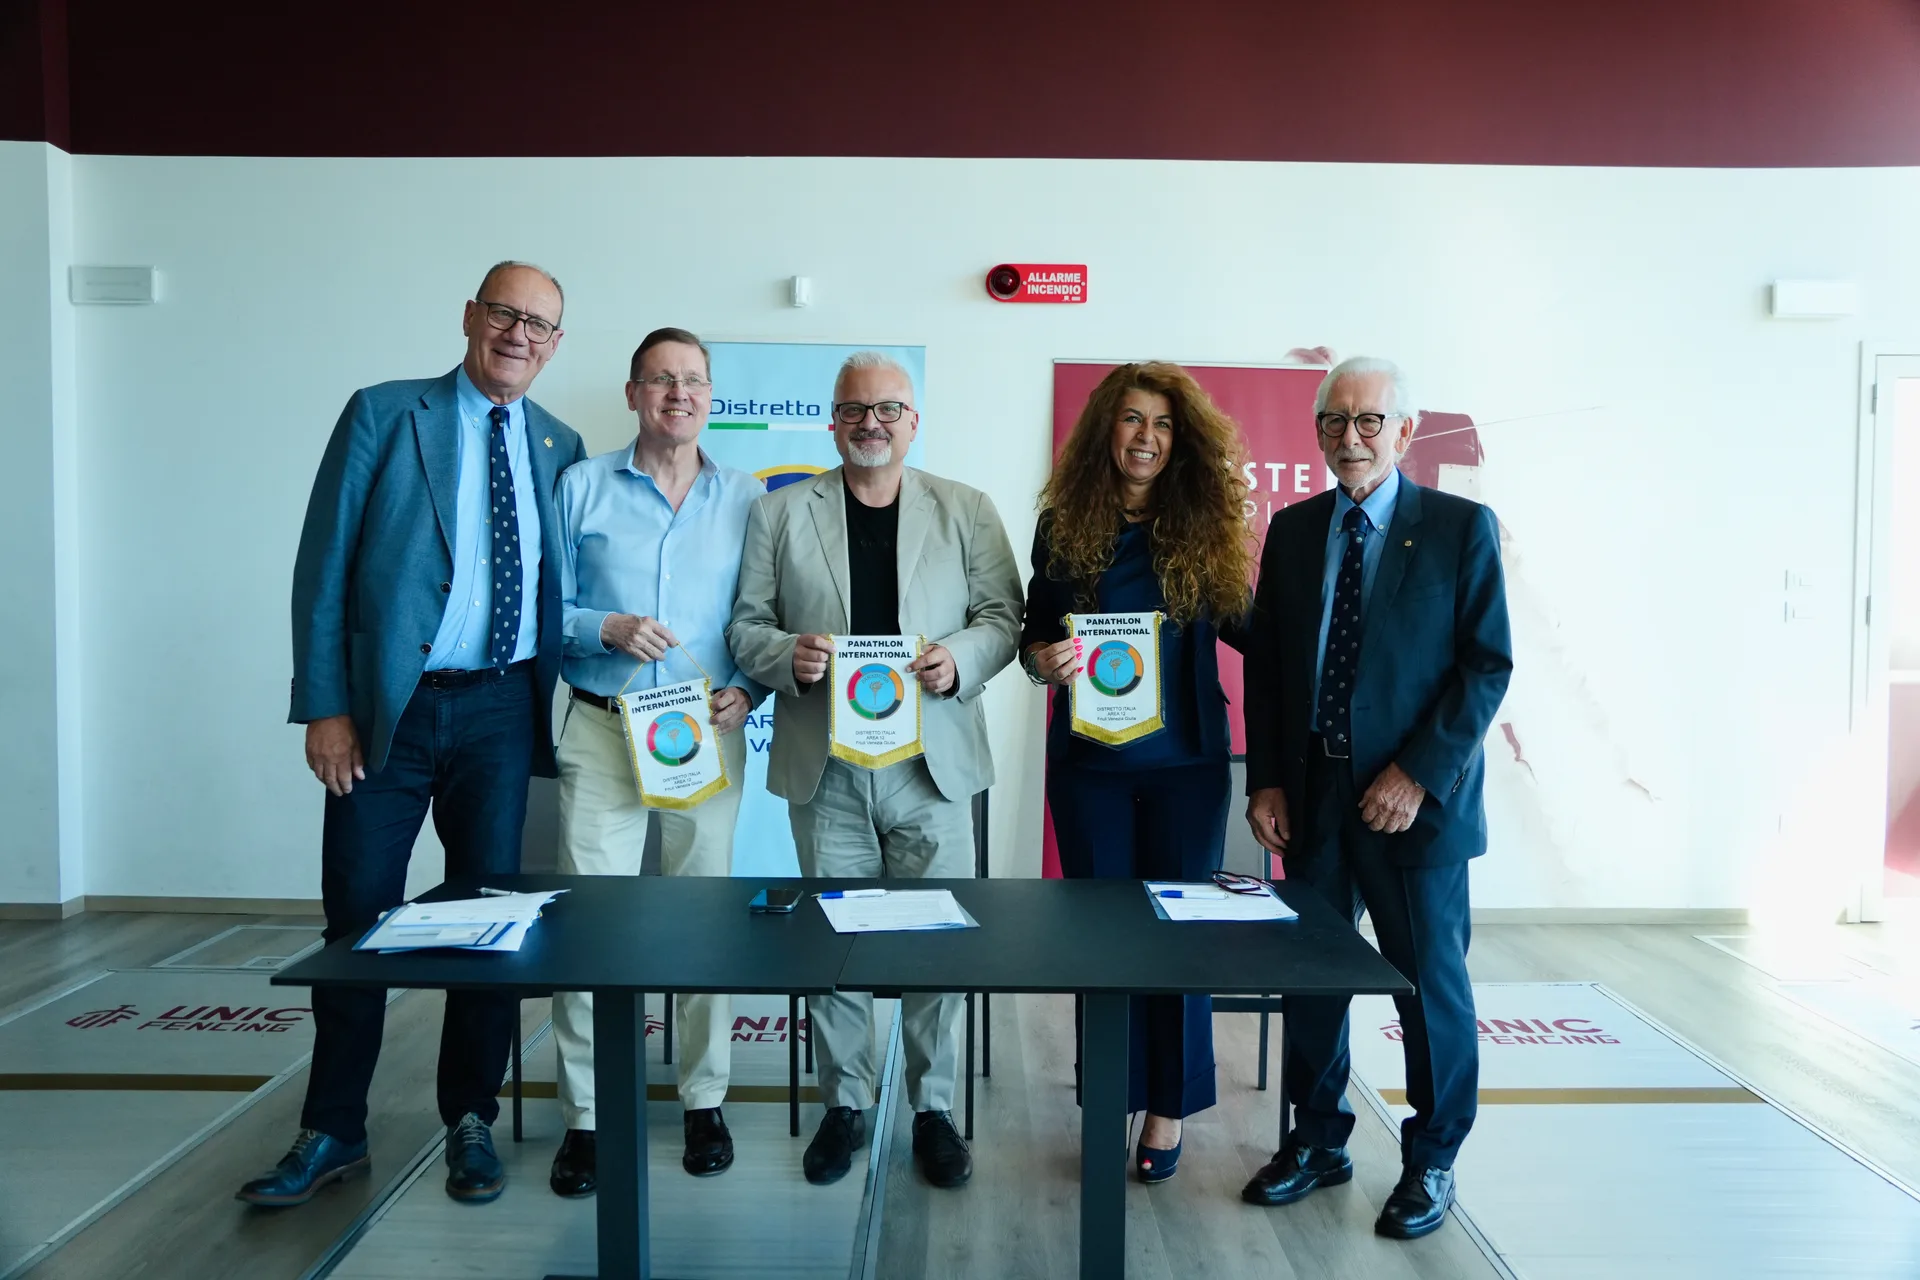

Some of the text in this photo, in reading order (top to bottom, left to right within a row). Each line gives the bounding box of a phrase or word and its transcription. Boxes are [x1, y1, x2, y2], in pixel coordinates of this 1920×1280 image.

[1027, 272, 1081, 283] ALLARME
[1027, 284, 1082, 295] INCENDIO
[709, 399, 820, 416] Distretto
[1241, 461, 1311, 493] STE
[1078, 628, 1150, 636] INTERNATIONAL
[847, 640, 903, 648] PANATHLON
[838, 651, 912, 659] INTERNATIONAL
[638, 685, 692, 702] PANATHLON
[632, 695, 702, 714] INTERNATIONAL
[156, 1005, 313, 1022] UNIC
[137, 1020, 295, 1033] FENCING
